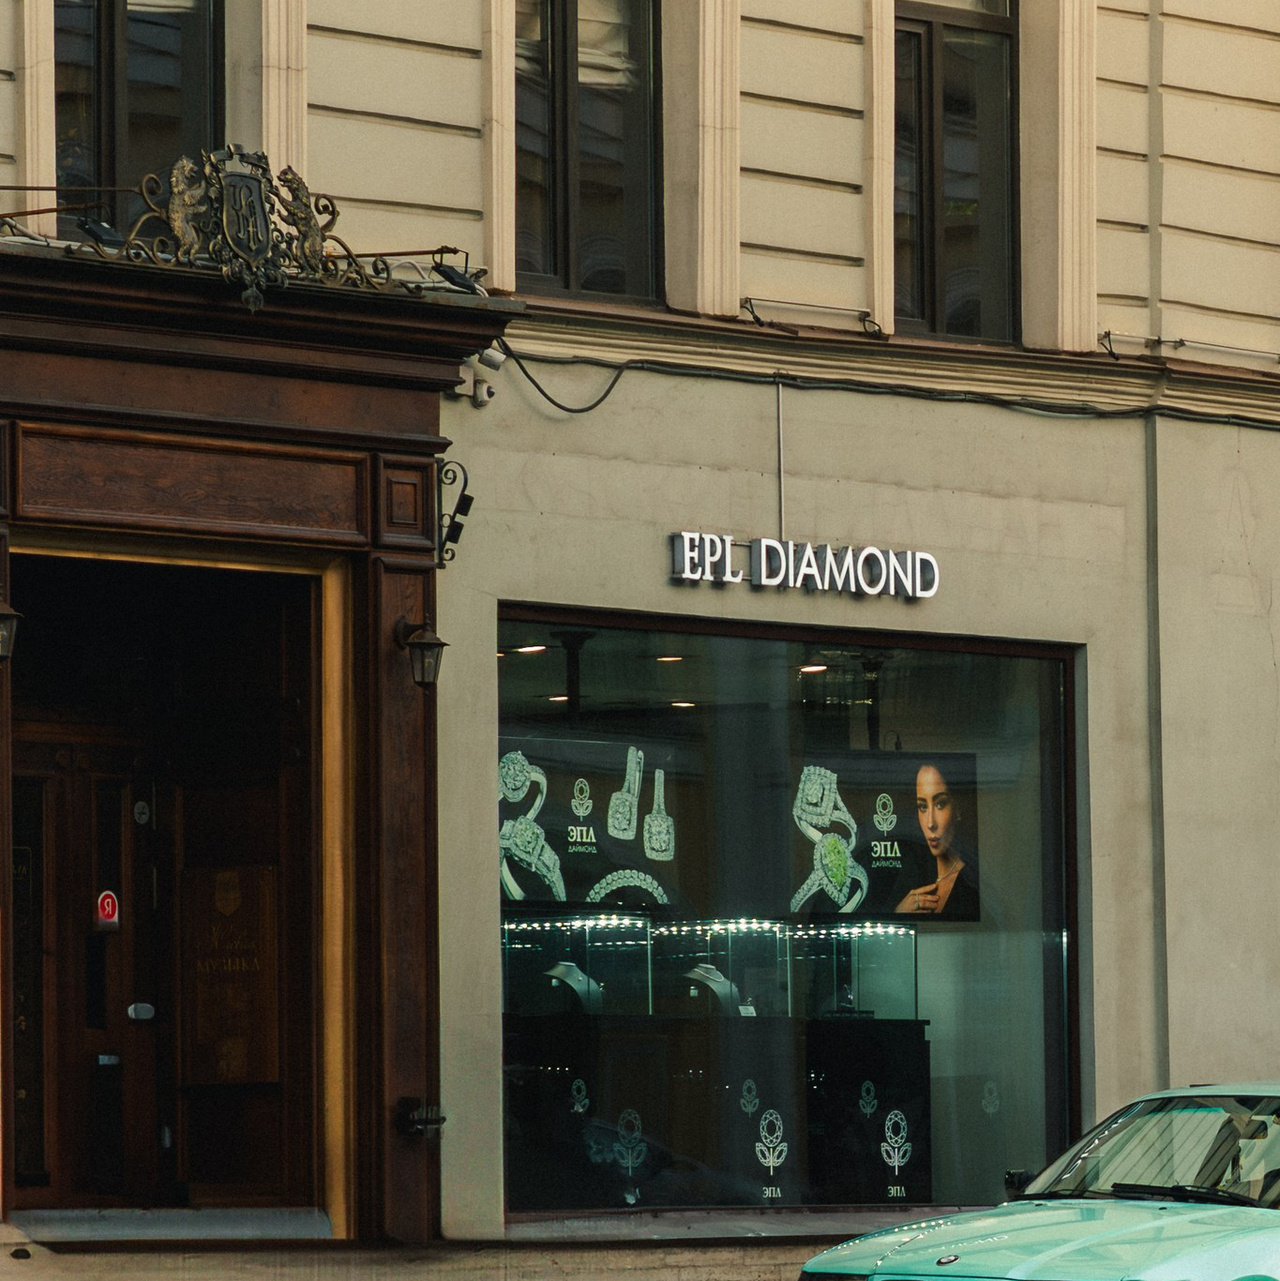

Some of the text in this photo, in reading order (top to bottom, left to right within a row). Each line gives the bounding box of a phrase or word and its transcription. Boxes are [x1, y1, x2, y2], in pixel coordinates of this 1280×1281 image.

[680, 531, 940, 598] EPL DIAMOND
[567, 826, 597, 842] ЭПЛ
[871, 841, 901, 857] ЭПЛ
[762, 1186, 781, 1198] ЭПЛ
[887, 1185, 906, 1198] ЭПЛ
